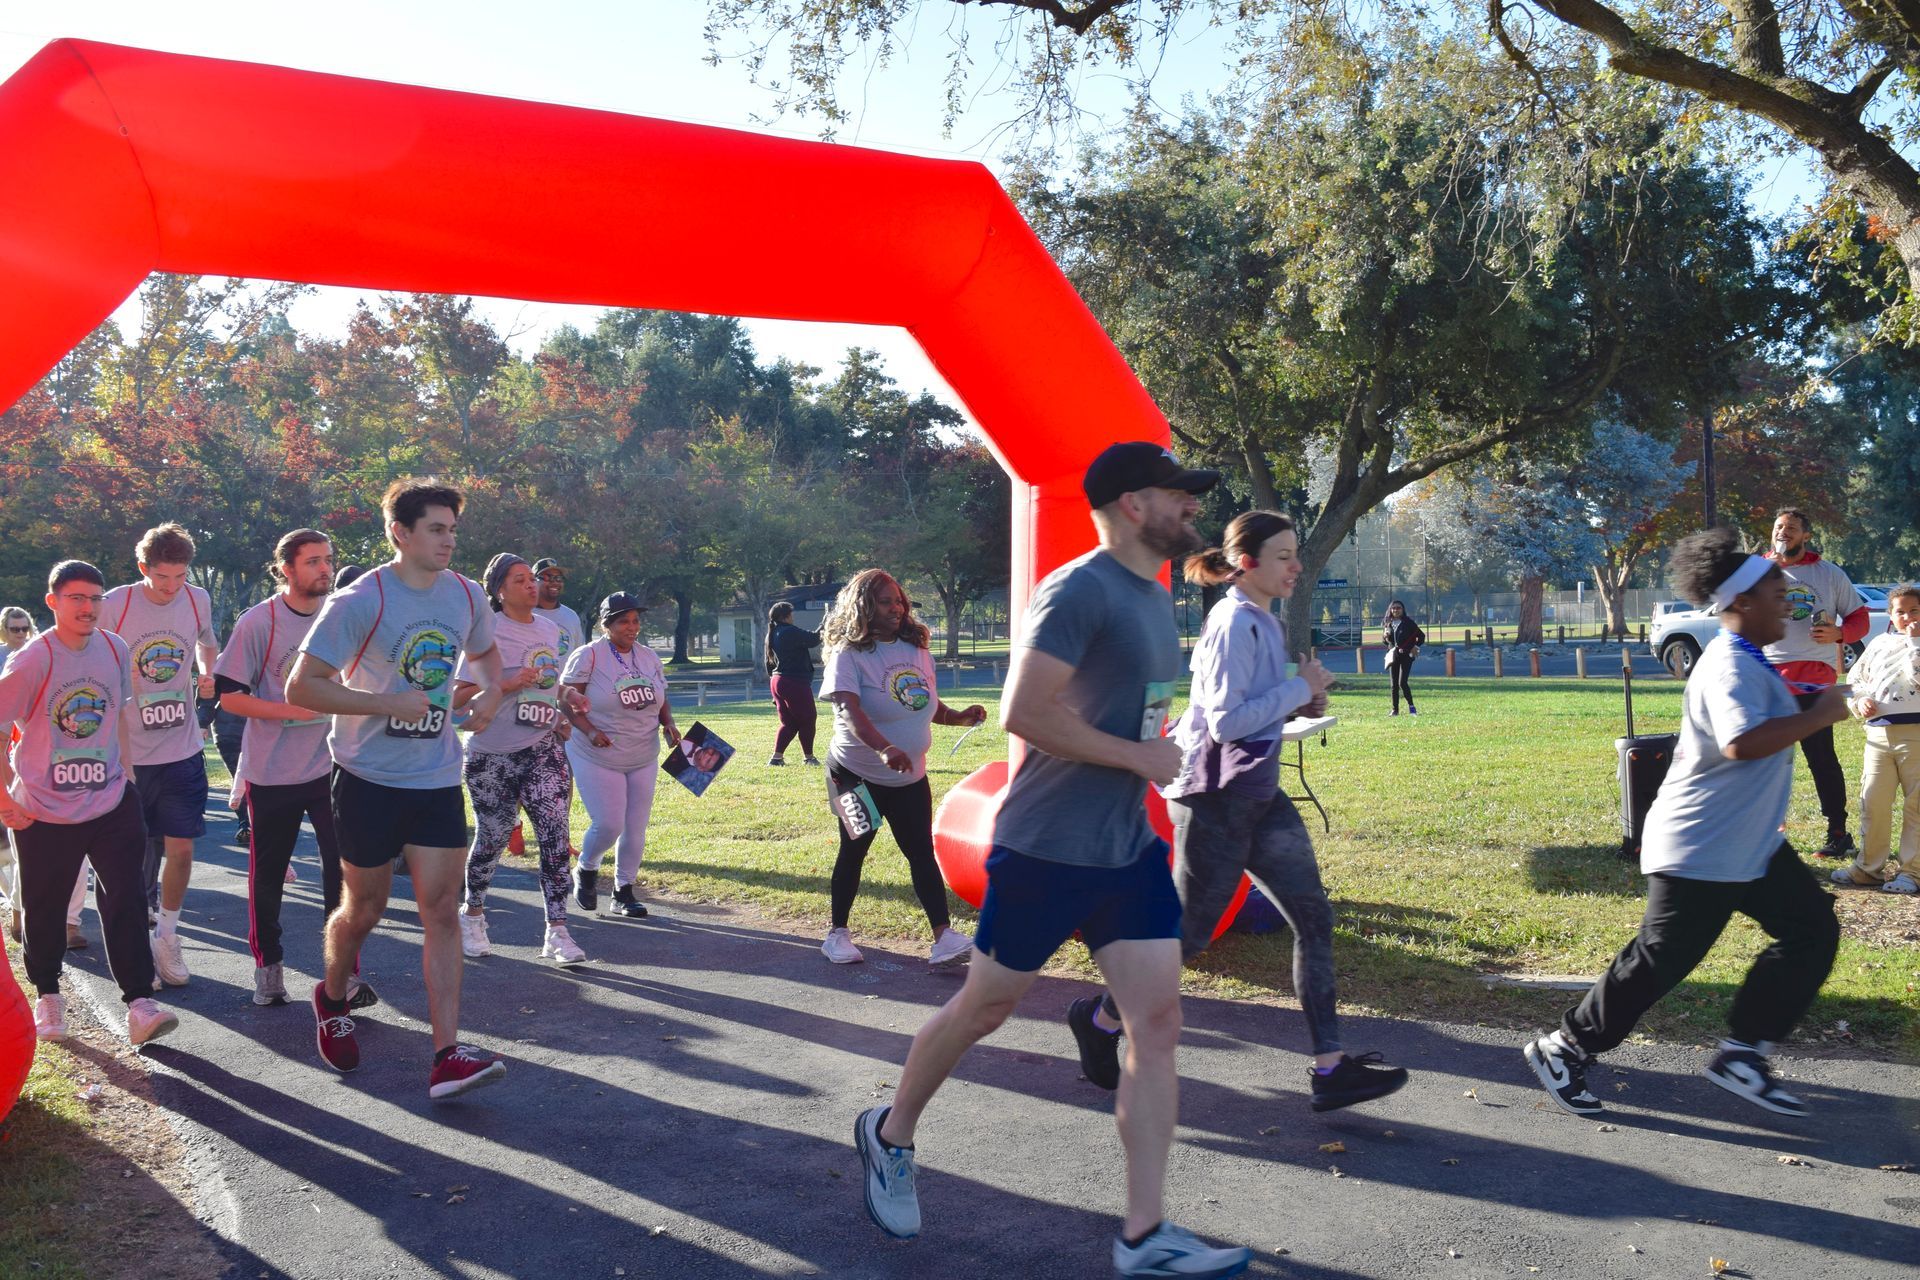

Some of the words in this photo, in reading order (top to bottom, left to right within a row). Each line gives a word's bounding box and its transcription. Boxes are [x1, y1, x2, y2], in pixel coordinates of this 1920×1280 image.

[620, 687, 654, 705] 6016
[141, 702, 186, 725] 6004
[518, 703, 554, 724] 6012
[53, 762, 106, 784] 6008
[839, 792, 871, 836] 6029
